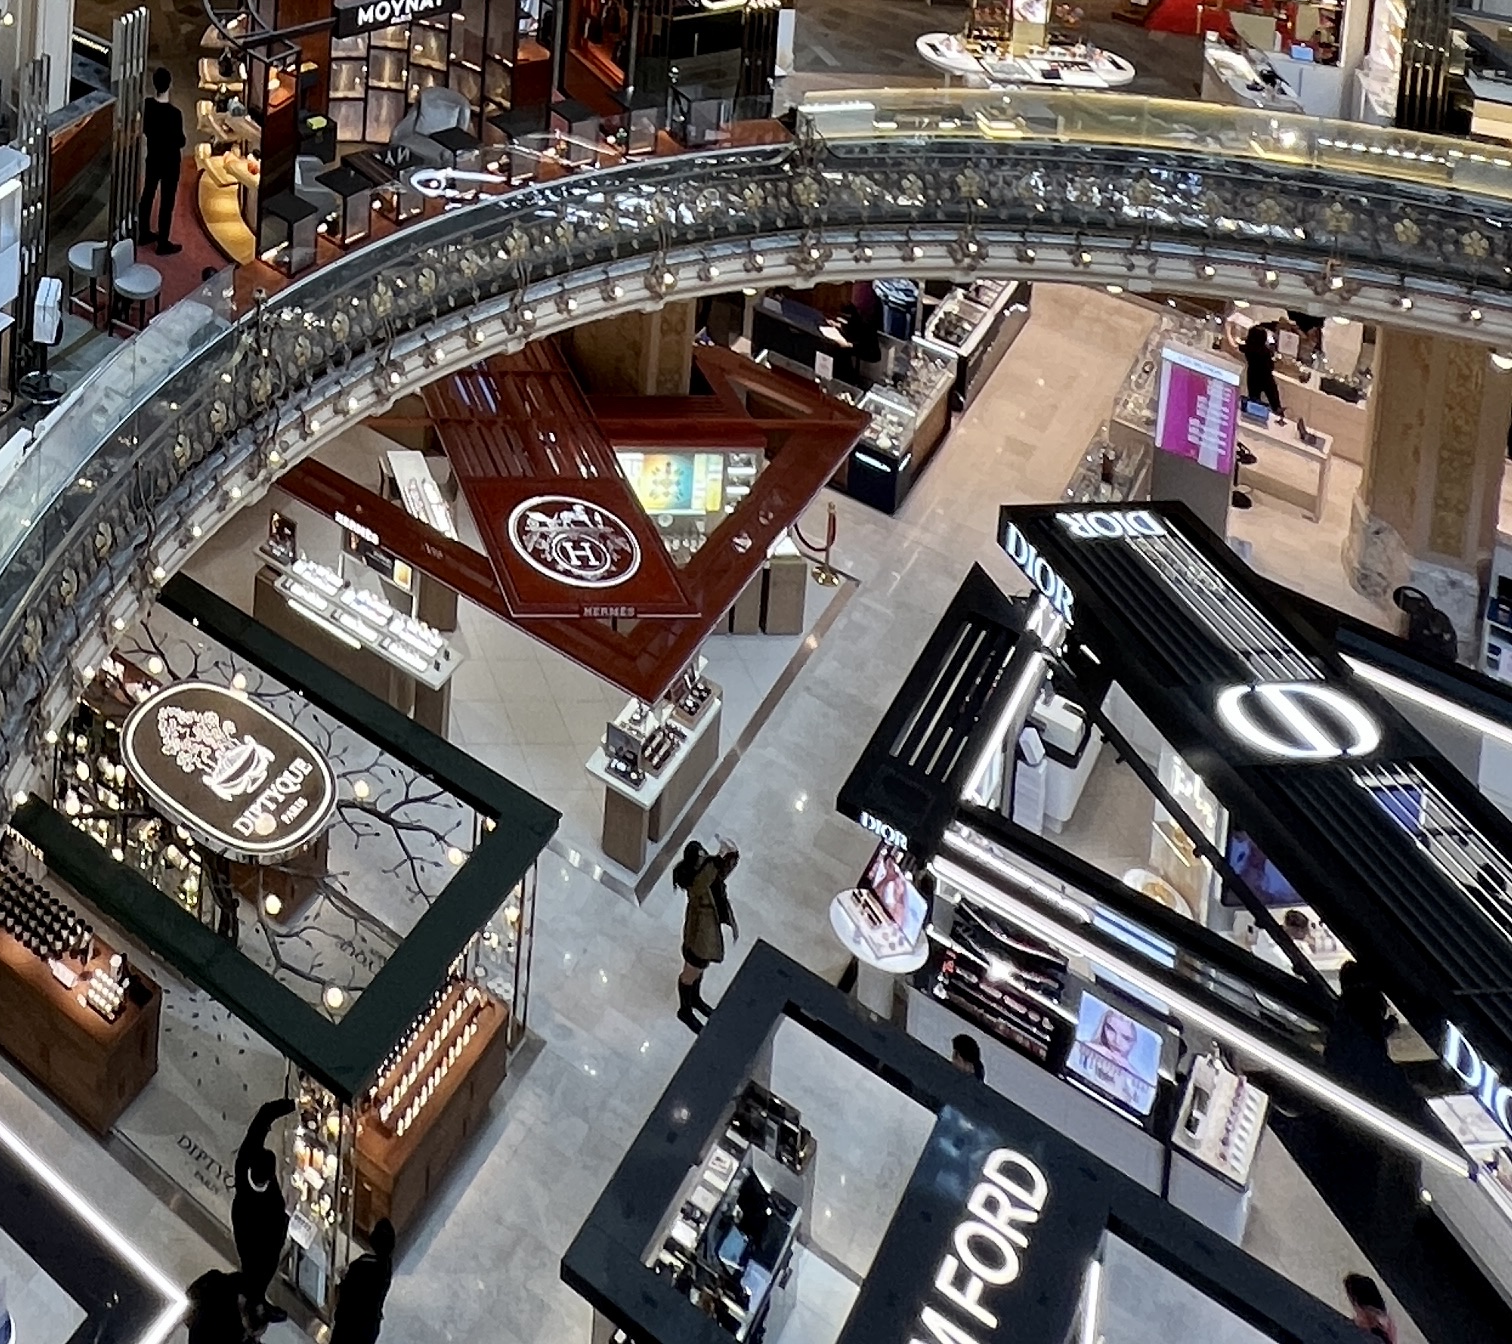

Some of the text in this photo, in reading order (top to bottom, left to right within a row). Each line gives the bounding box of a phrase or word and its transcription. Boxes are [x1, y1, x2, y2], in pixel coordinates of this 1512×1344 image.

[562, 540, 601, 567] H
[1055, 510, 1167, 539] DIOR
[1006, 520, 1075, 626] DIOR
[232, 757, 313, 837] DIPTYQUE
[859, 810, 908, 852] DIOR
[176, 1134, 236, 1193] DIPTYQ
[935, 1148, 1049, 1329] FORD
